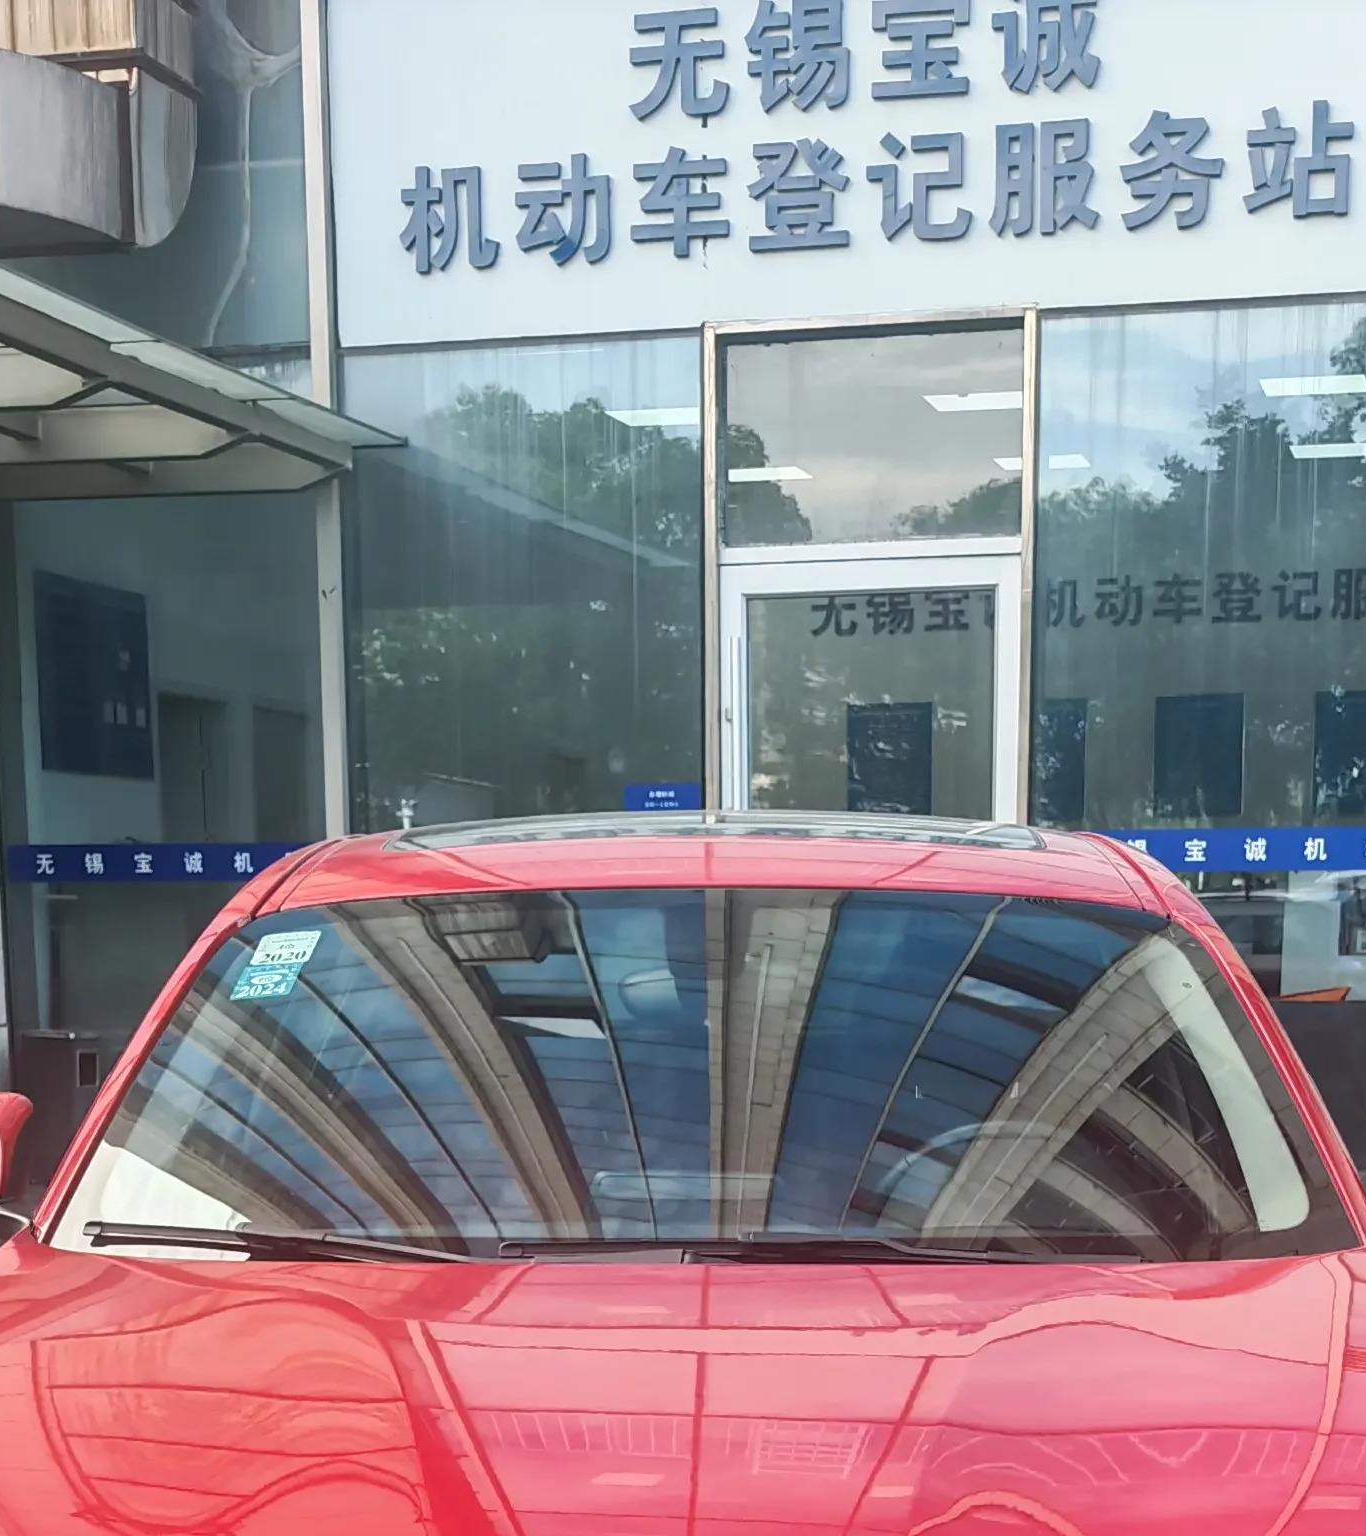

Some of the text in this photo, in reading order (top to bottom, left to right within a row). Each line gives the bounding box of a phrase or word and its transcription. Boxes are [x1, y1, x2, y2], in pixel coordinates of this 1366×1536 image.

[628, 0, 1102, 124] 无锡宝诚
[399, 99, 1355, 275] 机动车登记服务站
[810, 591, 995, 637] 无锡宝
[35, 852, 291, 876] 无锡宝诚机
[258, 950, 307, 964] 2020
[235, 982, 288, 998] 2024
